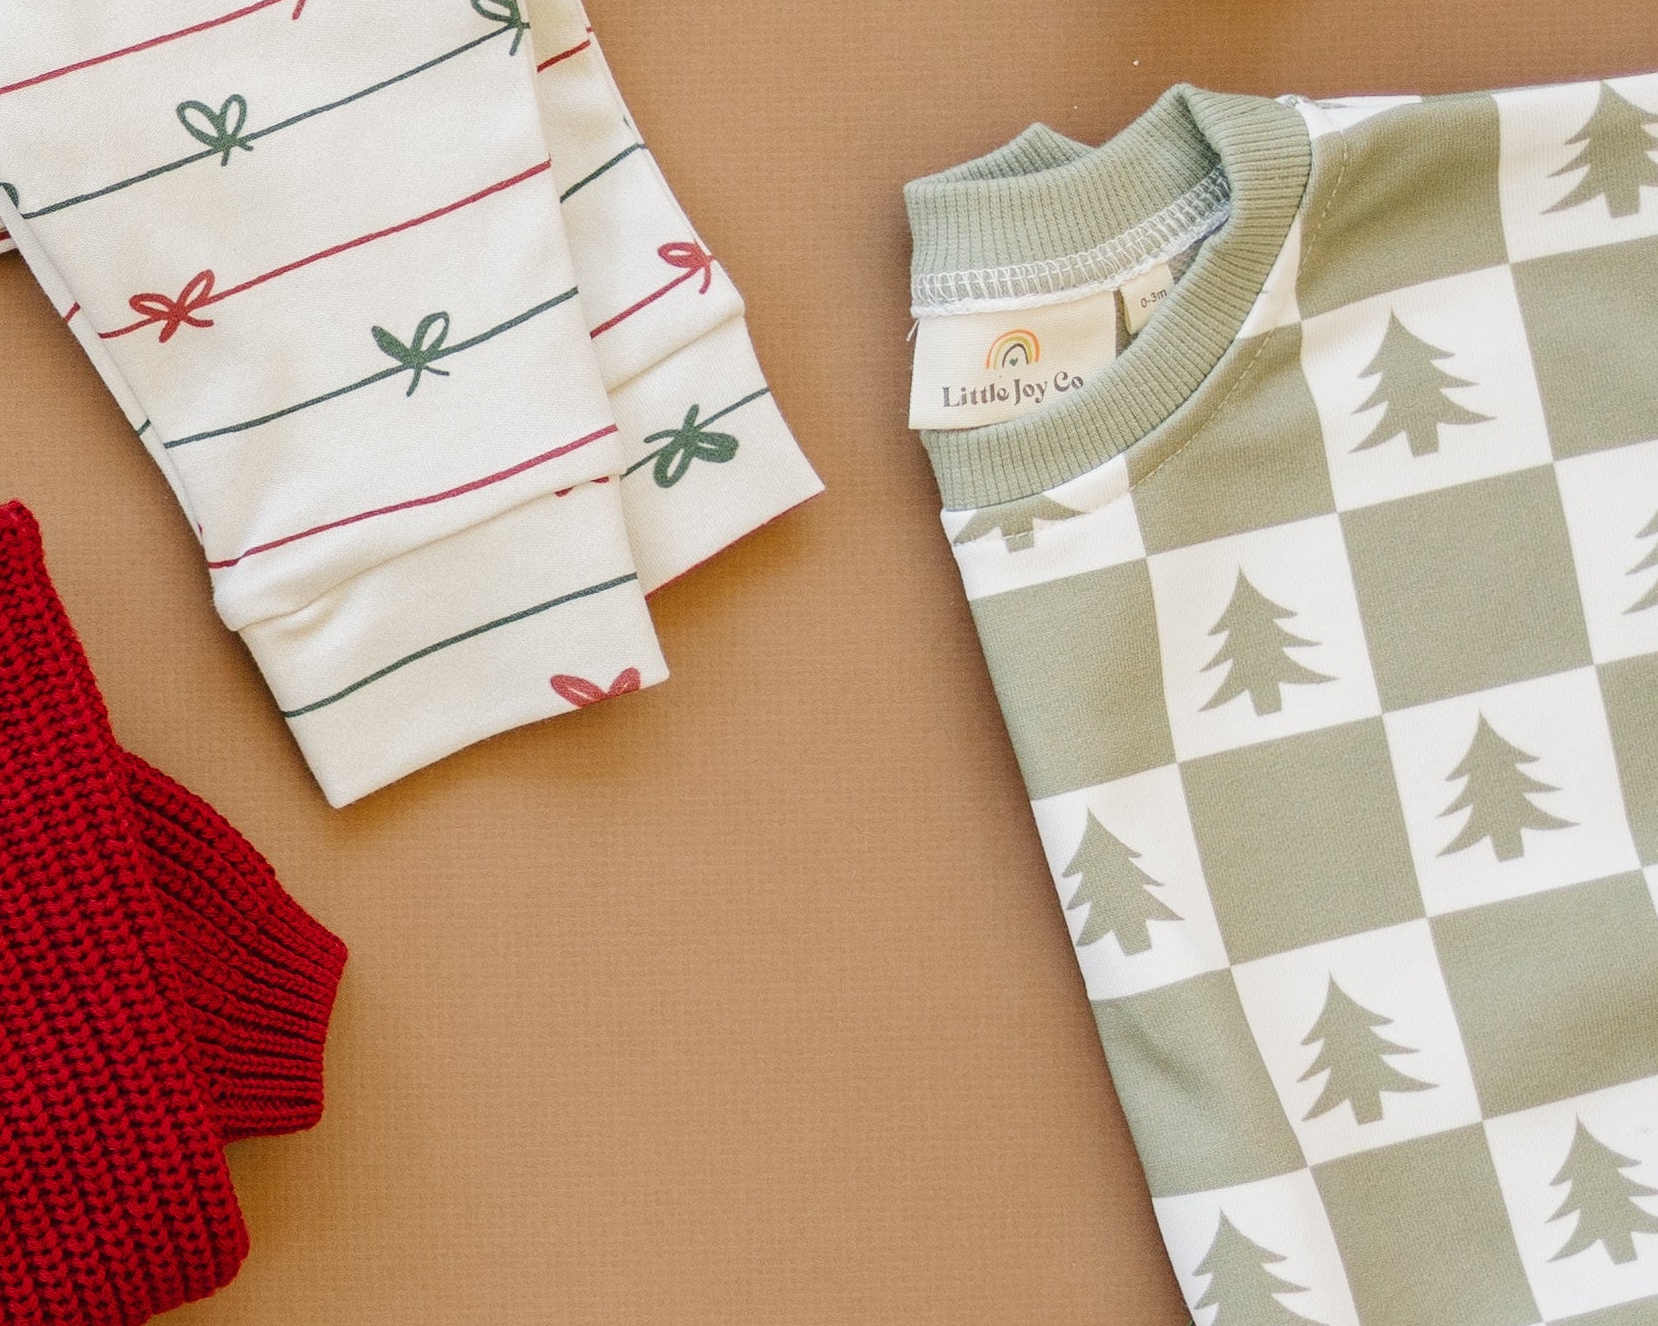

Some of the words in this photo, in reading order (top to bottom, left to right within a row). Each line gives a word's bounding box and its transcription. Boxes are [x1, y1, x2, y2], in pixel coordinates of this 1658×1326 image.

[1140, 289, 1167, 308] 0-3m
[942, 382, 1009, 408] Little
[1013, 378, 1049, 405] Joy
